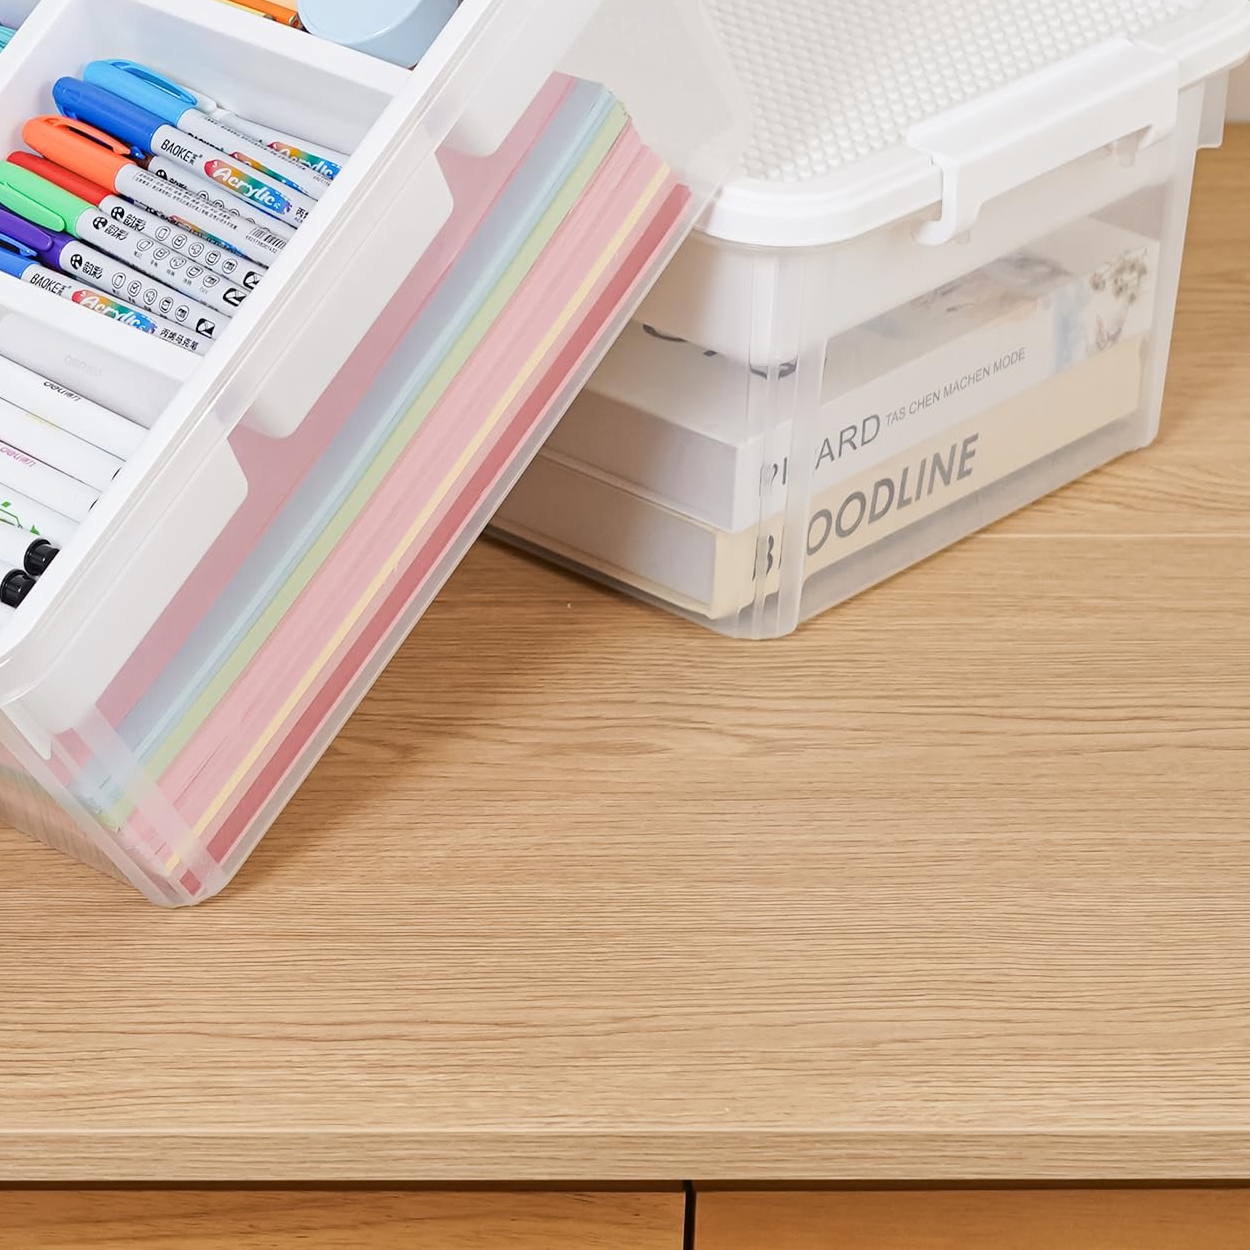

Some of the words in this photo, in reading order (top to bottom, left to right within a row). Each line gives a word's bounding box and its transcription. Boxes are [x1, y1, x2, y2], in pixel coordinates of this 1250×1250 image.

[886, 406, 906, 426] TAS
[909, 389, 941, 415] CHEN
[943, 365, 991, 398] MACHEN
[993, 347, 1026, 375] MODE
